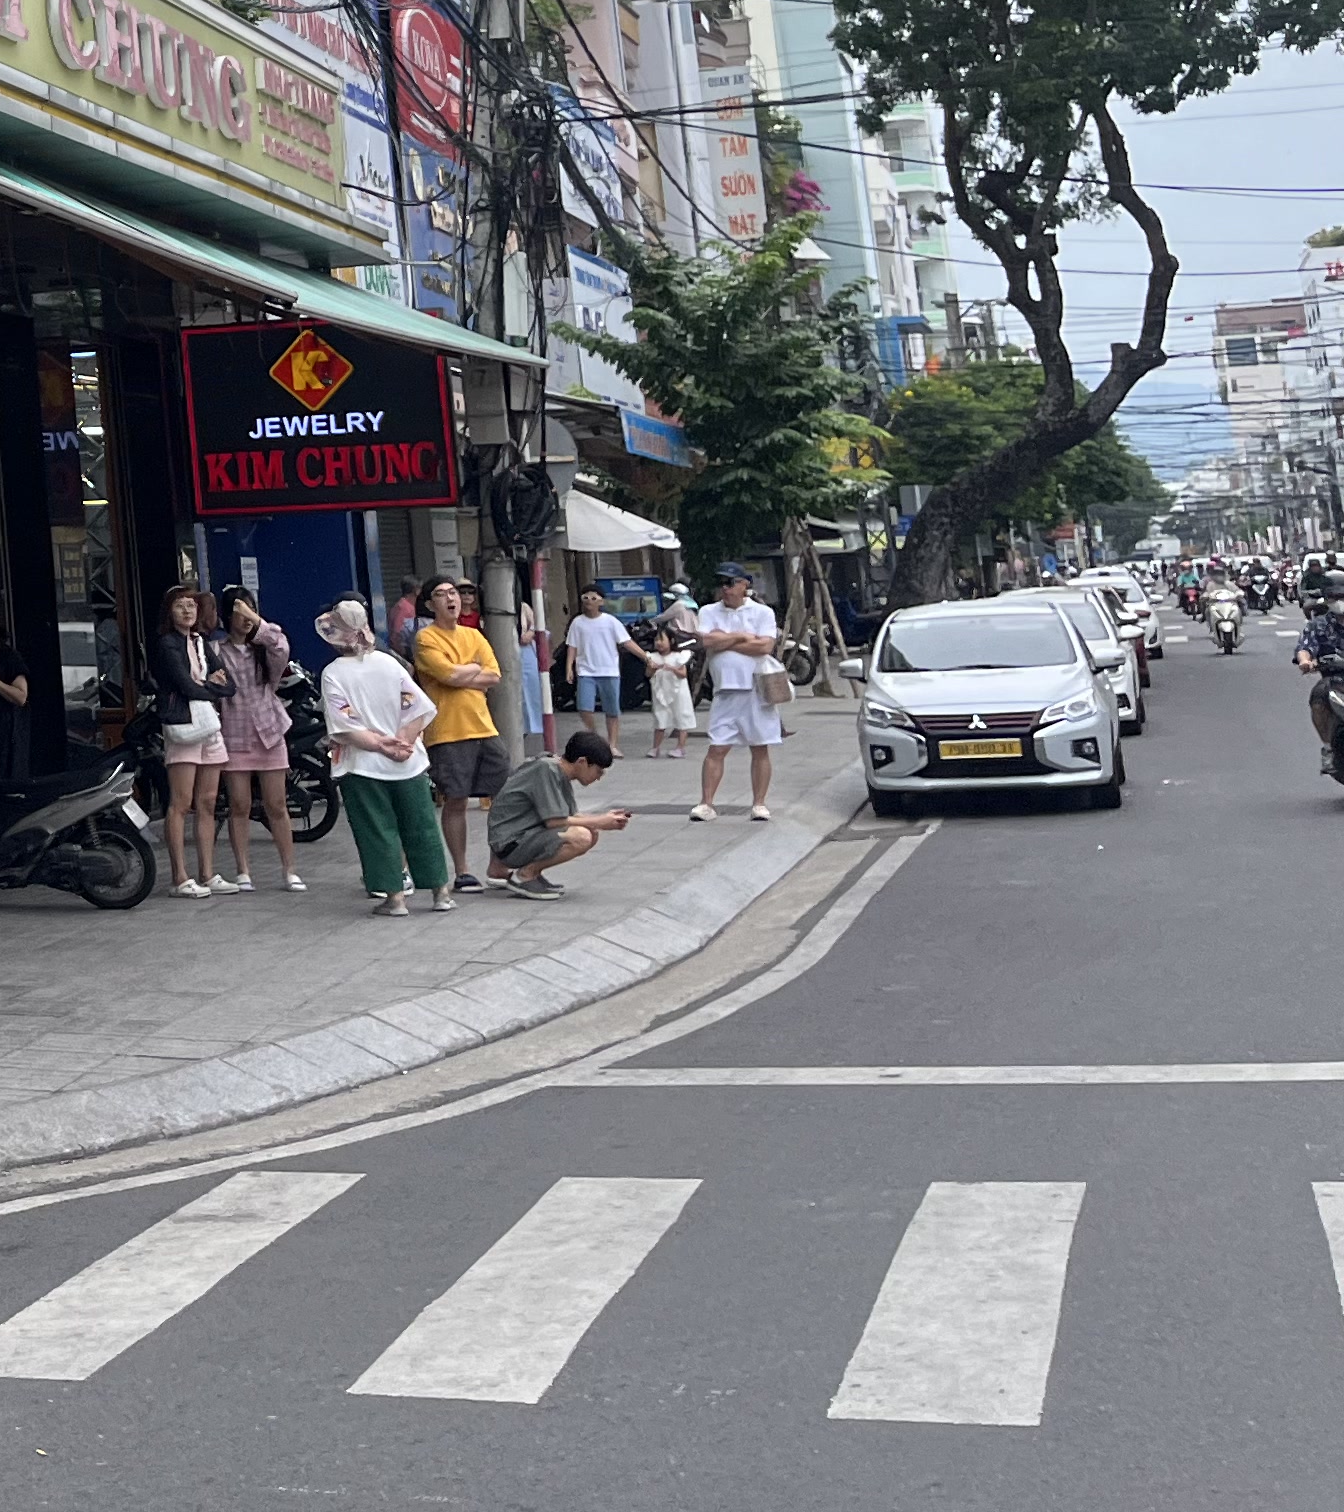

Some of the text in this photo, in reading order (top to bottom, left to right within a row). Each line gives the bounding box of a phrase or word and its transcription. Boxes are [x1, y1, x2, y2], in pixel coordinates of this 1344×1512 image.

[248, 411, 386, 440] JEWELRY
[204, 441, 441, 493] KIM CHUNG
